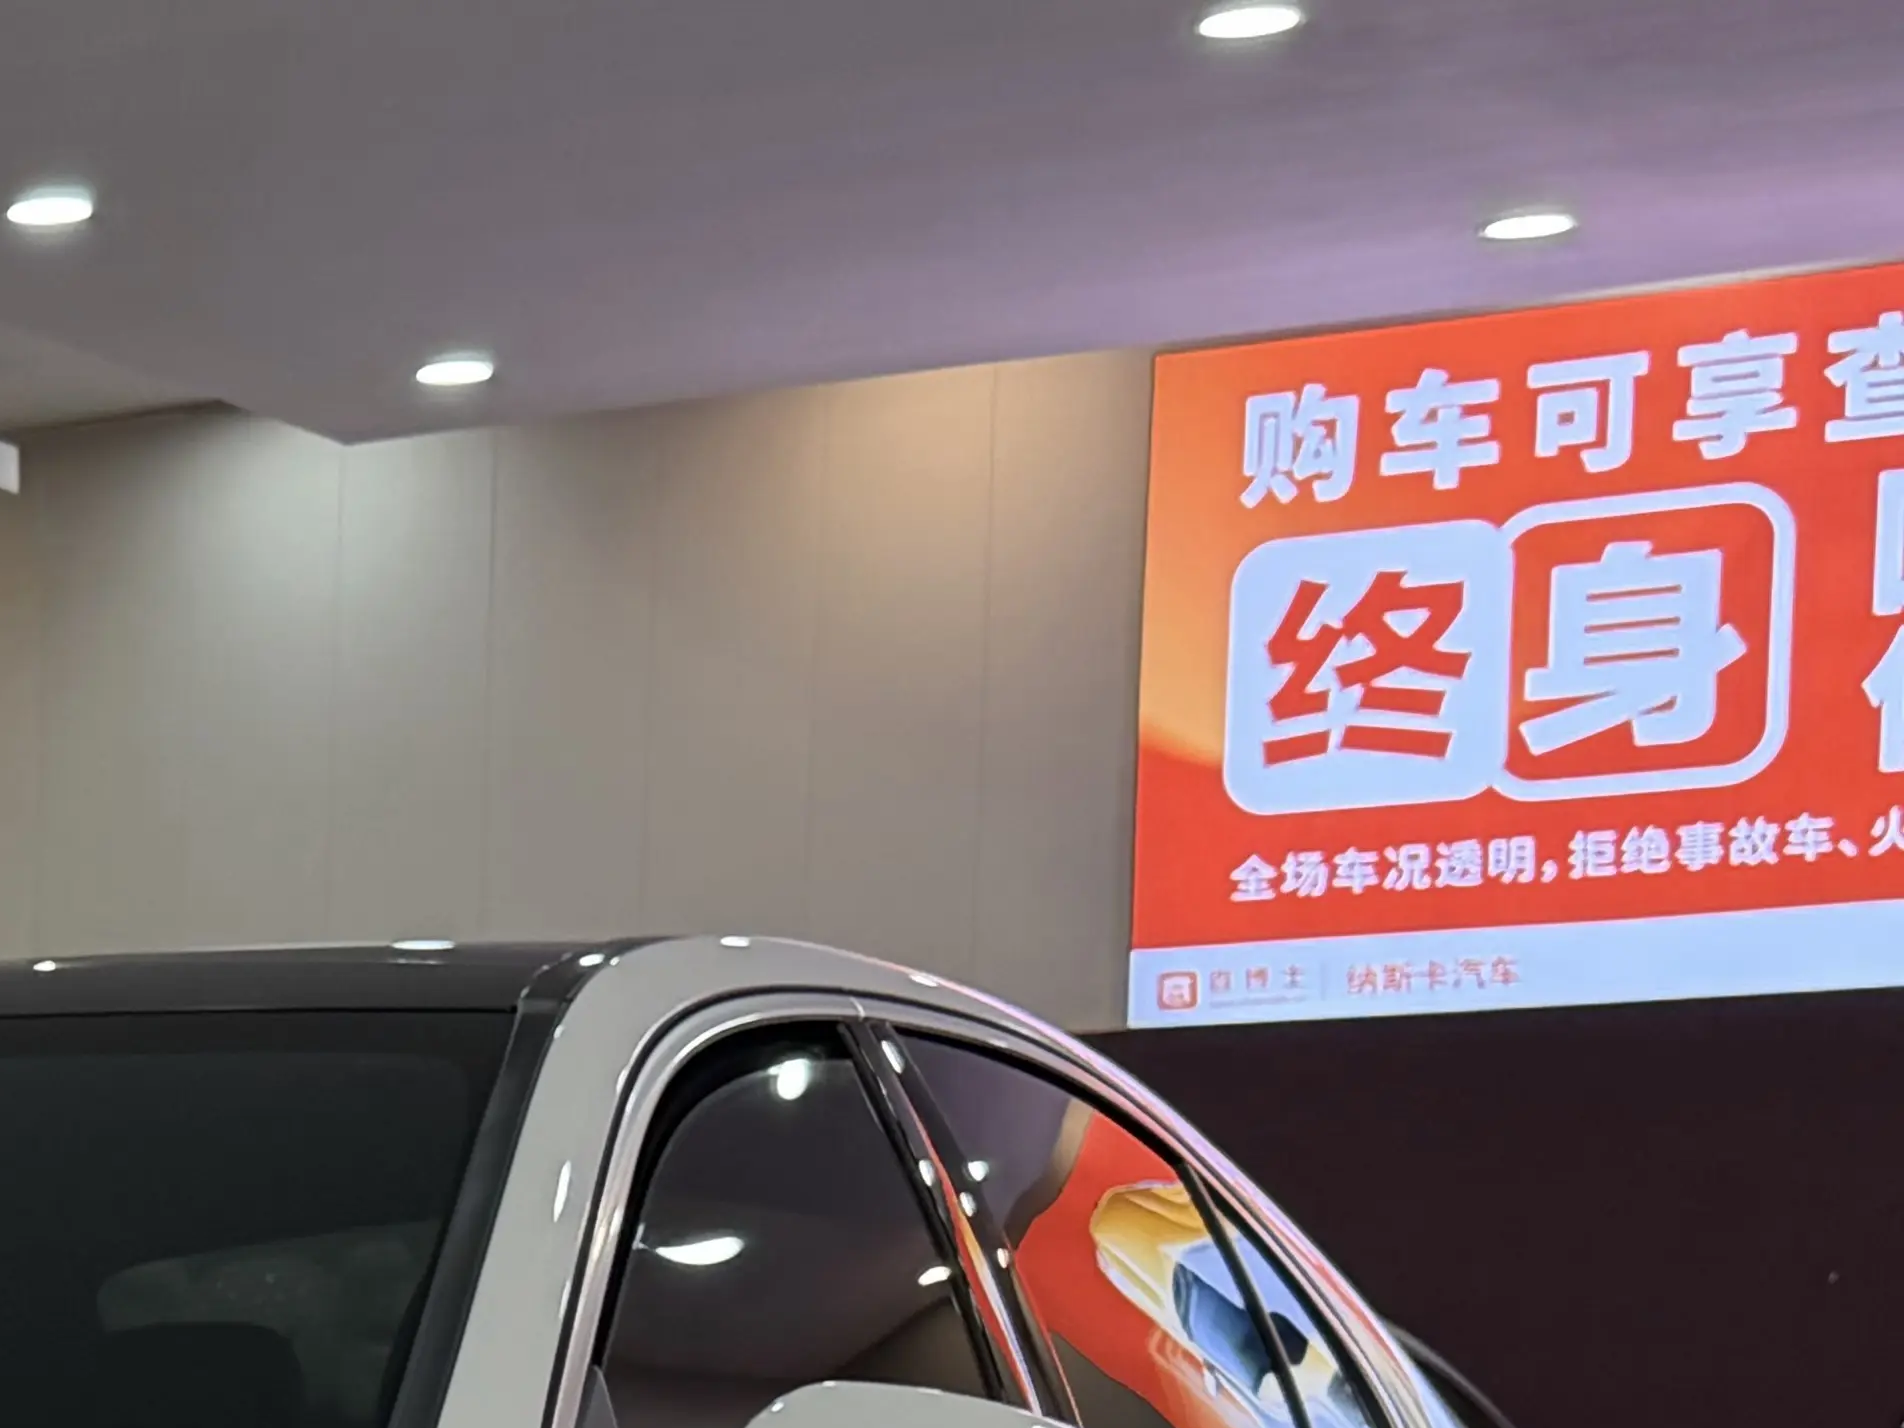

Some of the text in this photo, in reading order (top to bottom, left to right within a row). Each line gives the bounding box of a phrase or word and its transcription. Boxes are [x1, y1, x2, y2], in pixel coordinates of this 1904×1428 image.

[1262, 540, 1747, 769] 终身
[1346, 956, 1522, 995] 纳斯卡汽车
